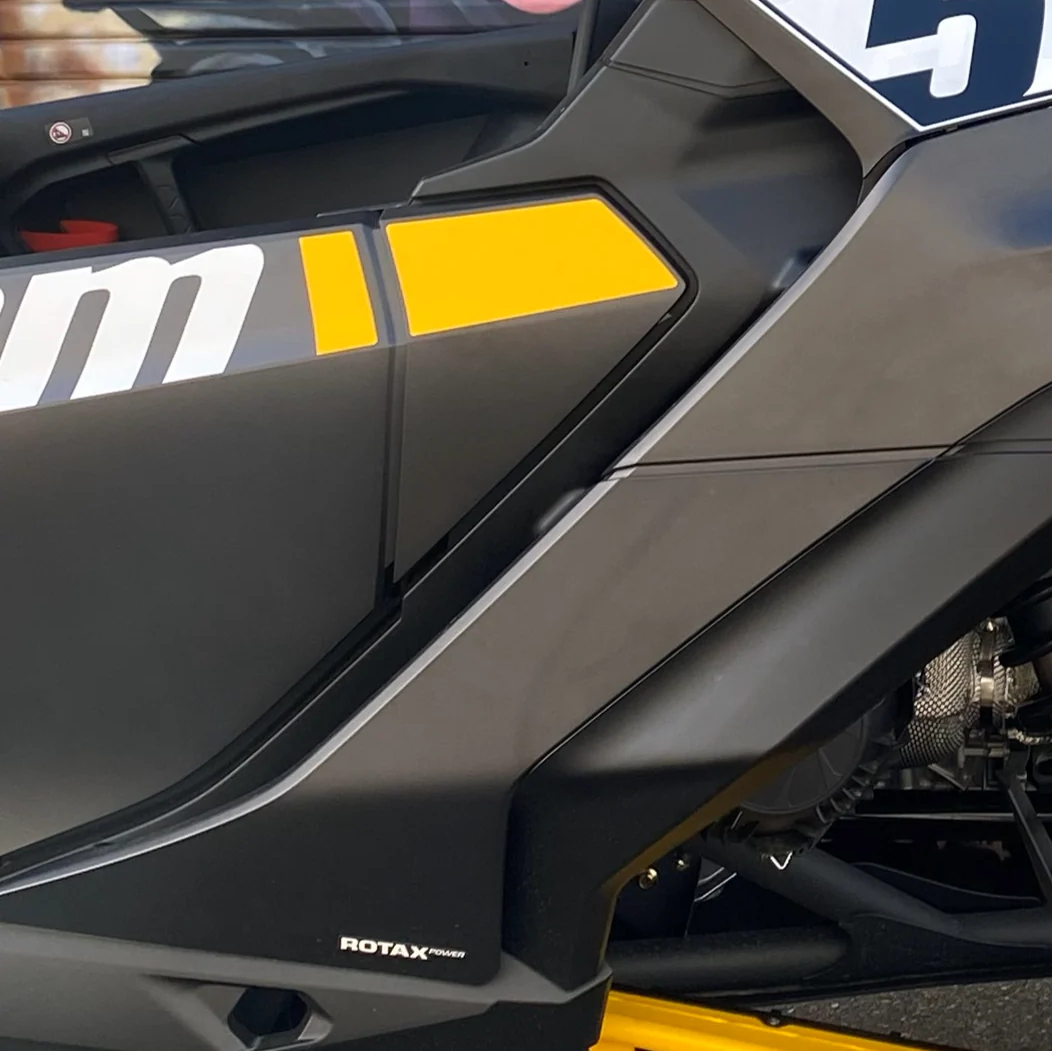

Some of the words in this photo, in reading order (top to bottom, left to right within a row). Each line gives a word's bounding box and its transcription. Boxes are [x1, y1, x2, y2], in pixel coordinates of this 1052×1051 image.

[0, 243, 265, 412] m
[340, 936, 429, 960] ROTAX
[428, 948, 466, 959] POWER
